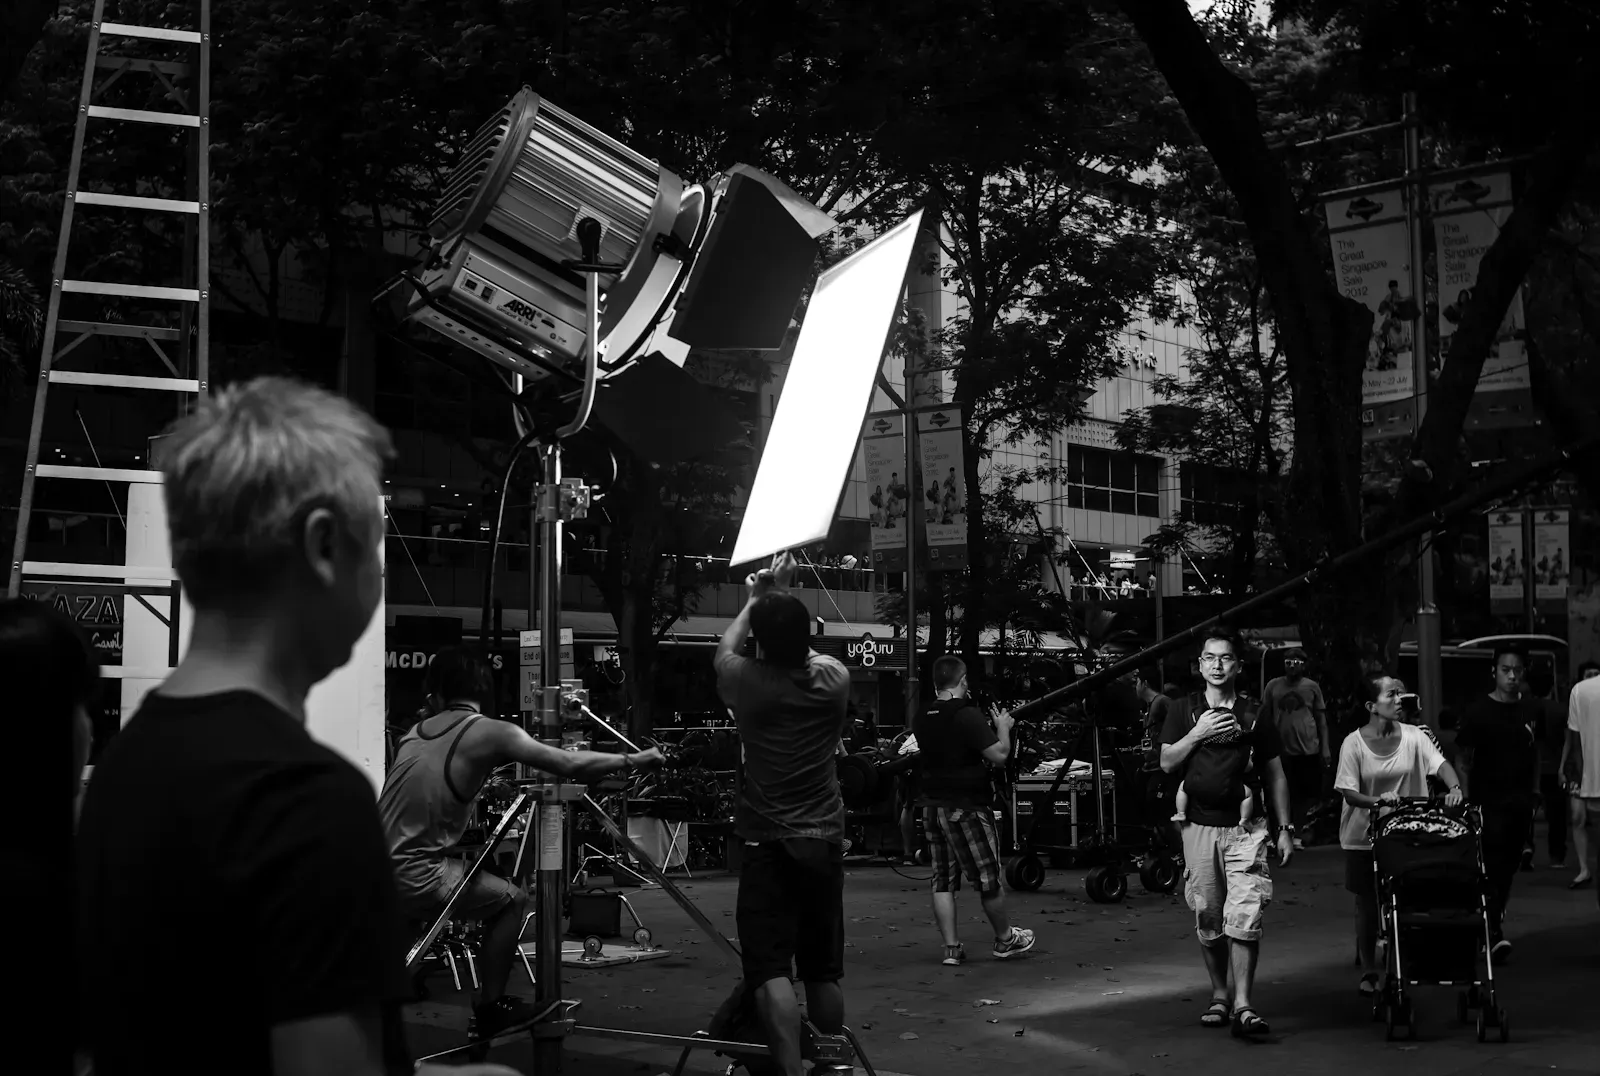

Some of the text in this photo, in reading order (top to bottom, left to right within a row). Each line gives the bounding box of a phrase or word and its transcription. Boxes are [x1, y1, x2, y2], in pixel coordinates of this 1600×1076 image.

[1336, 239, 1355, 250] The
[1339, 249, 1365, 263] Great
[1341, 260, 1388, 275] Singapore
[1343, 275, 1363, 287] Sale
[1345, 286, 1368, 298] 2012
[503, 299, 537, 321] ARRI
[524, 651, 534, 660] End
[847, 640, 894, 667] yoguru
